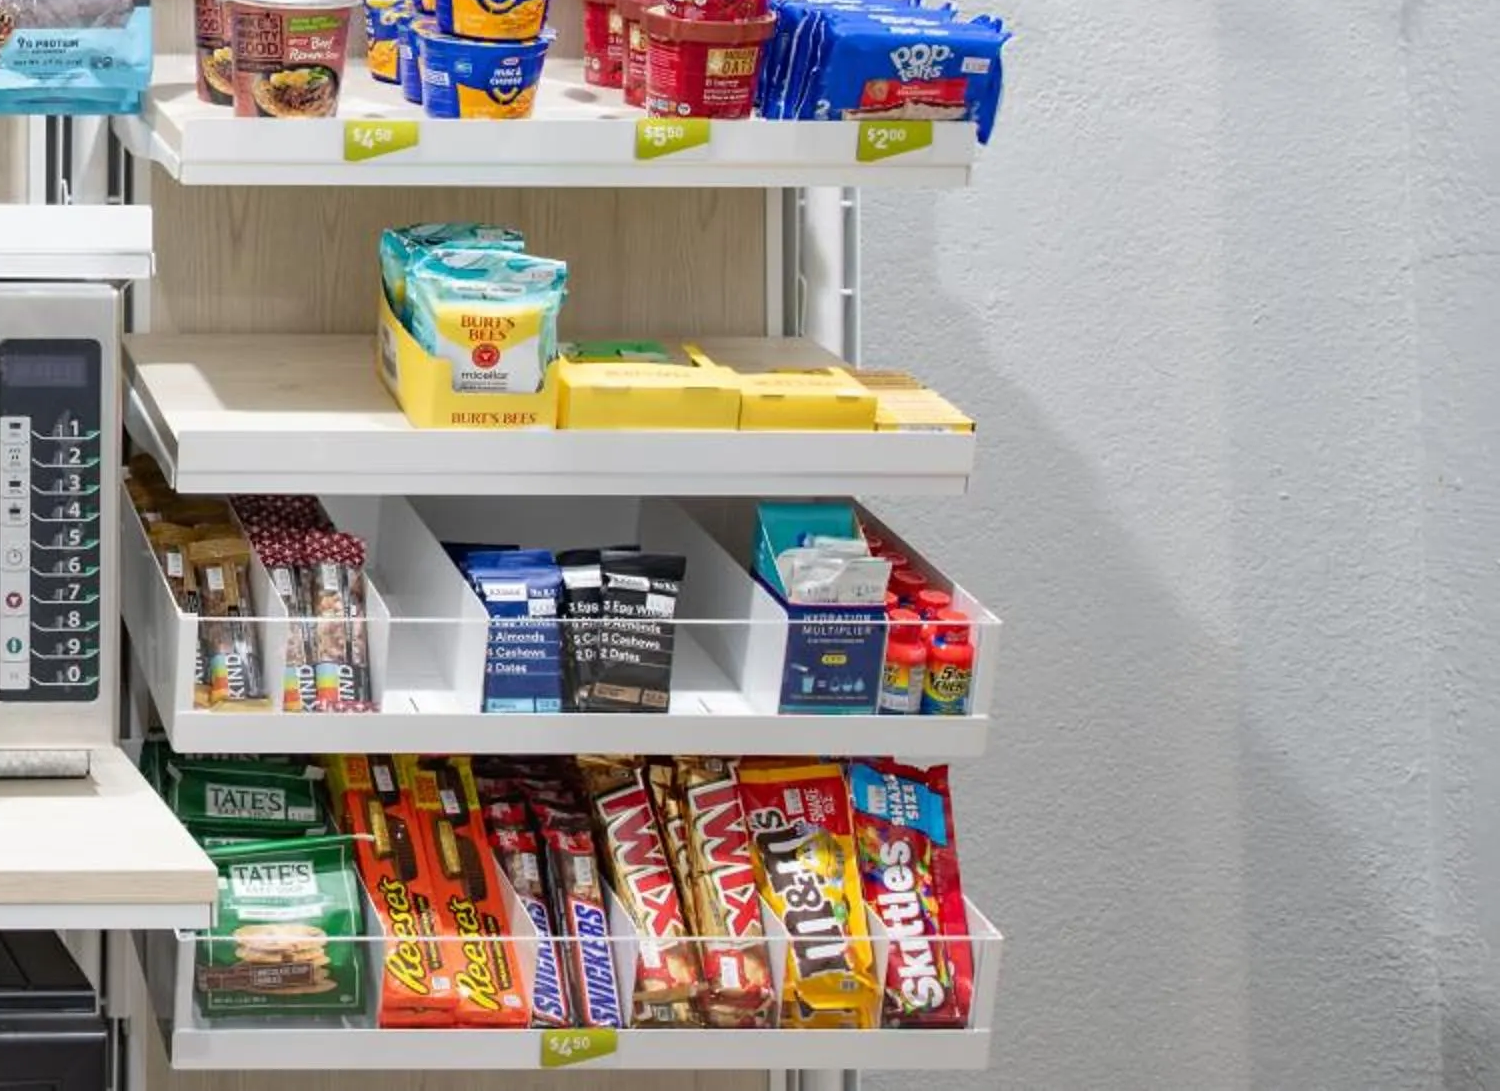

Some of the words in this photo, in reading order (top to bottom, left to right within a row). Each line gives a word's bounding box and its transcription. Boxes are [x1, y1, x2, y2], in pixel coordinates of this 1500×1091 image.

[460, 314, 515, 329] BURT'S
[468, 328, 507, 342] BEES
[451, 411, 500, 424] BURT'S
[503, 411, 538, 424] BEES
[70, 420, 81, 436] 1
[68, 448, 81, 464] 2
[68, 475, 81, 491] 3
[68, 503, 81, 518] 4
[68, 530, 81, 545] 5
[68, 557, 81, 573] 6
[70, 584, 81, 600] 7
[613, 600, 633, 616] Egg
[68, 612, 81, 627] 8
[495, 630, 545, 643] Almonds
[803, 624, 871, 637] MULTIPLIER
[68, 639, 81, 655] 9
[611, 632, 661, 651] Cashews
[495, 646, 547, 659] Cashews
[609, 648, 640, 664] Dates
[68, 666, 81, 682] 0
[495, 661, 528, 674] Dates
[227, 652, 245, 700] KIND
[338, 664, 354, 701] IND
[209, 787, 283, 812] TATE'S
[233, 864, 311, 886] TATE'S
[574, 903, 621, 1027] SNICKERS
